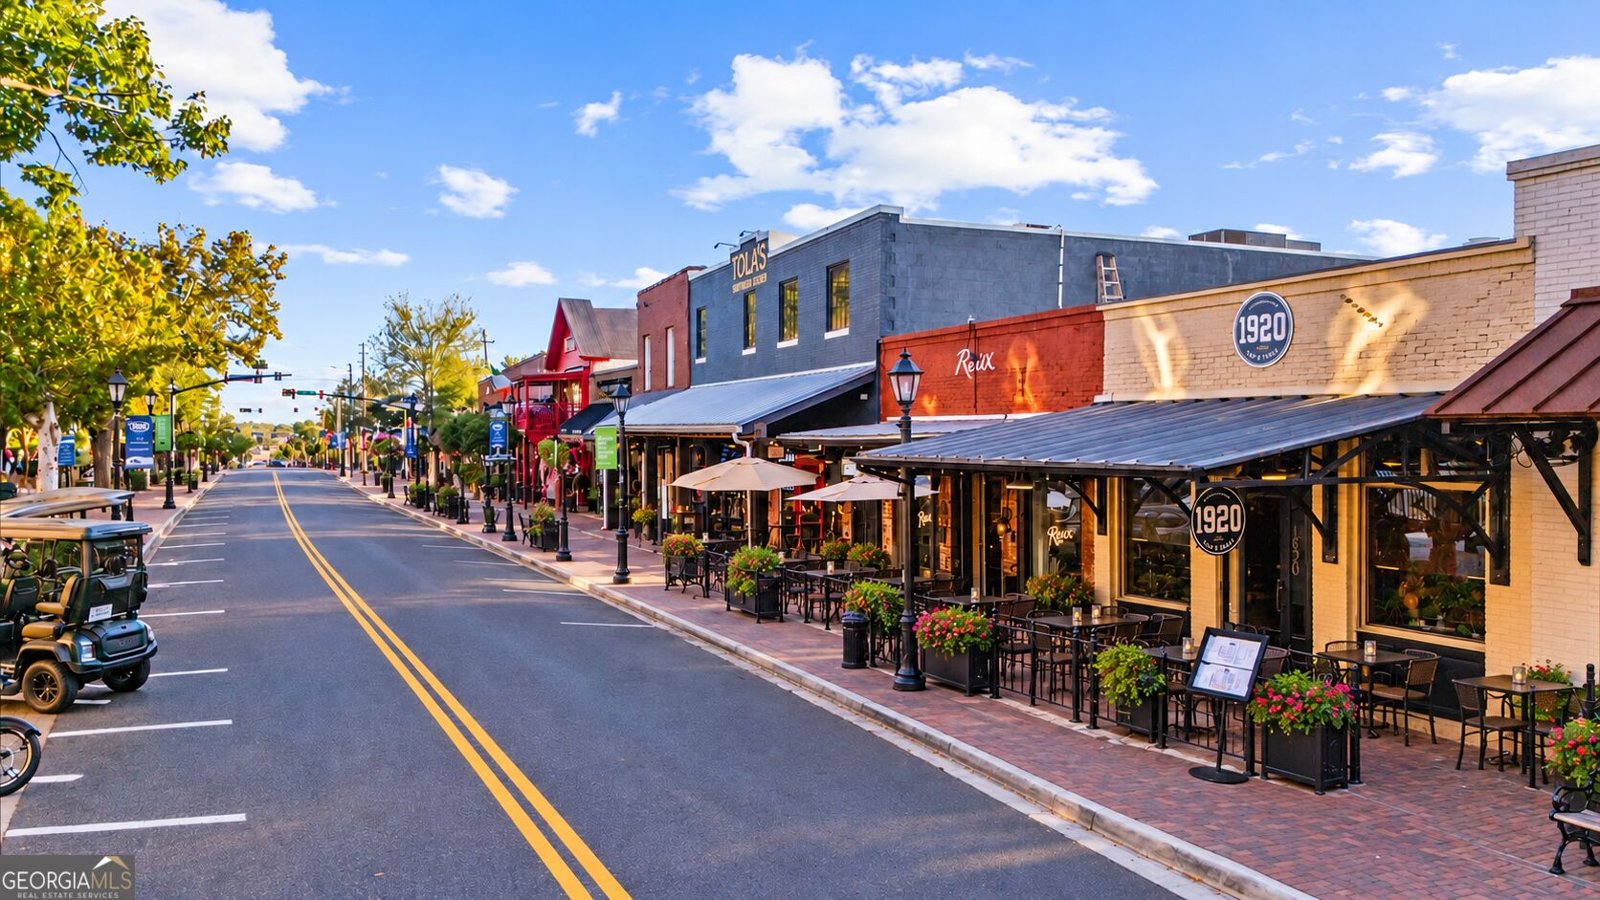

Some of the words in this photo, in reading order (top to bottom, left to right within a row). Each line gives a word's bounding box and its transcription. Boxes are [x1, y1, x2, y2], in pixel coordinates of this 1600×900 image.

[732, 242, 767, 280] TOLA'S
[1239, 312, 1286, 344] 1920
[1196, 504, 1242, 534] 1920
